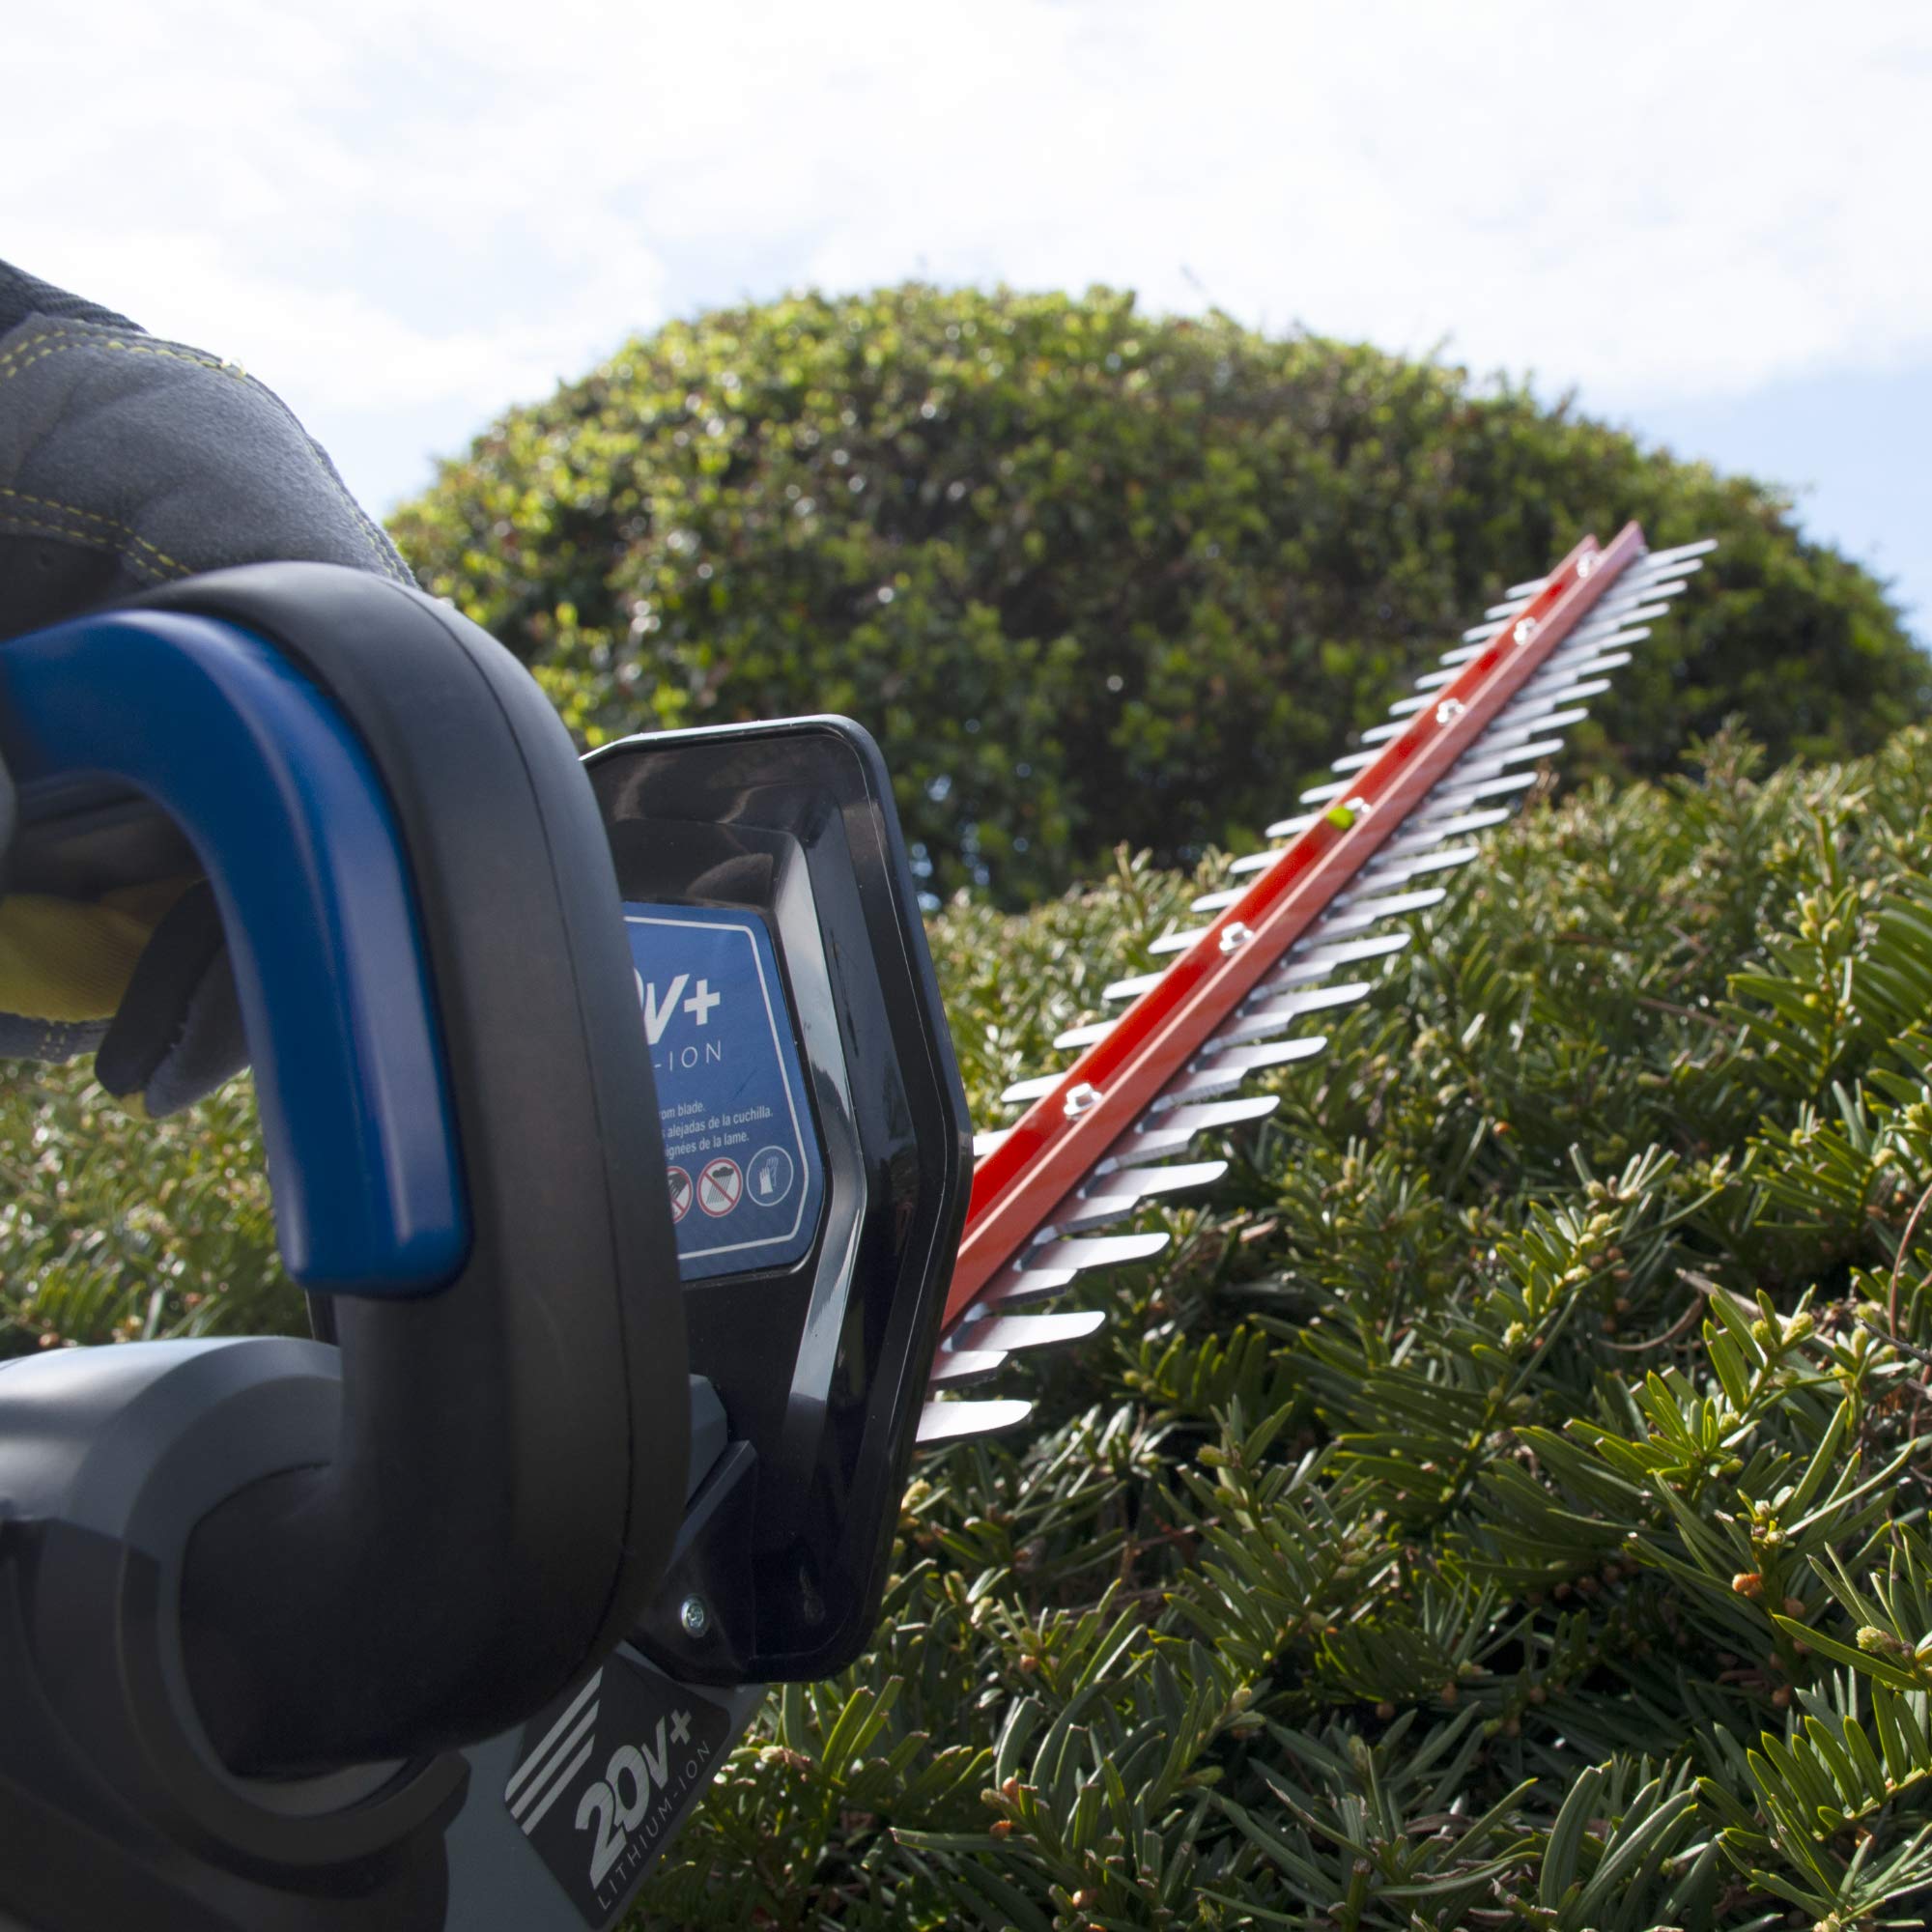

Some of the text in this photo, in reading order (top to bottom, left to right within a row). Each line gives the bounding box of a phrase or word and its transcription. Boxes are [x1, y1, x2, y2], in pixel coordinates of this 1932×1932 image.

[634, 967, 721, 1045] V+
[668, 1121, 705, 1139] alejadas
[708, 1116, 721, 1129] de
[723, 1114, 731, 1126] la
[733, 1105, 773, 1124] cuchilla.
[677, 1101, 705, 1117] blade.
[698, 1137, 711, 1151] de
[713, 1135, 722, 1148] la
[724, 1131, 750, 1145] lame.
[598, 1741, 710, 1910] LITHIUM-ION
